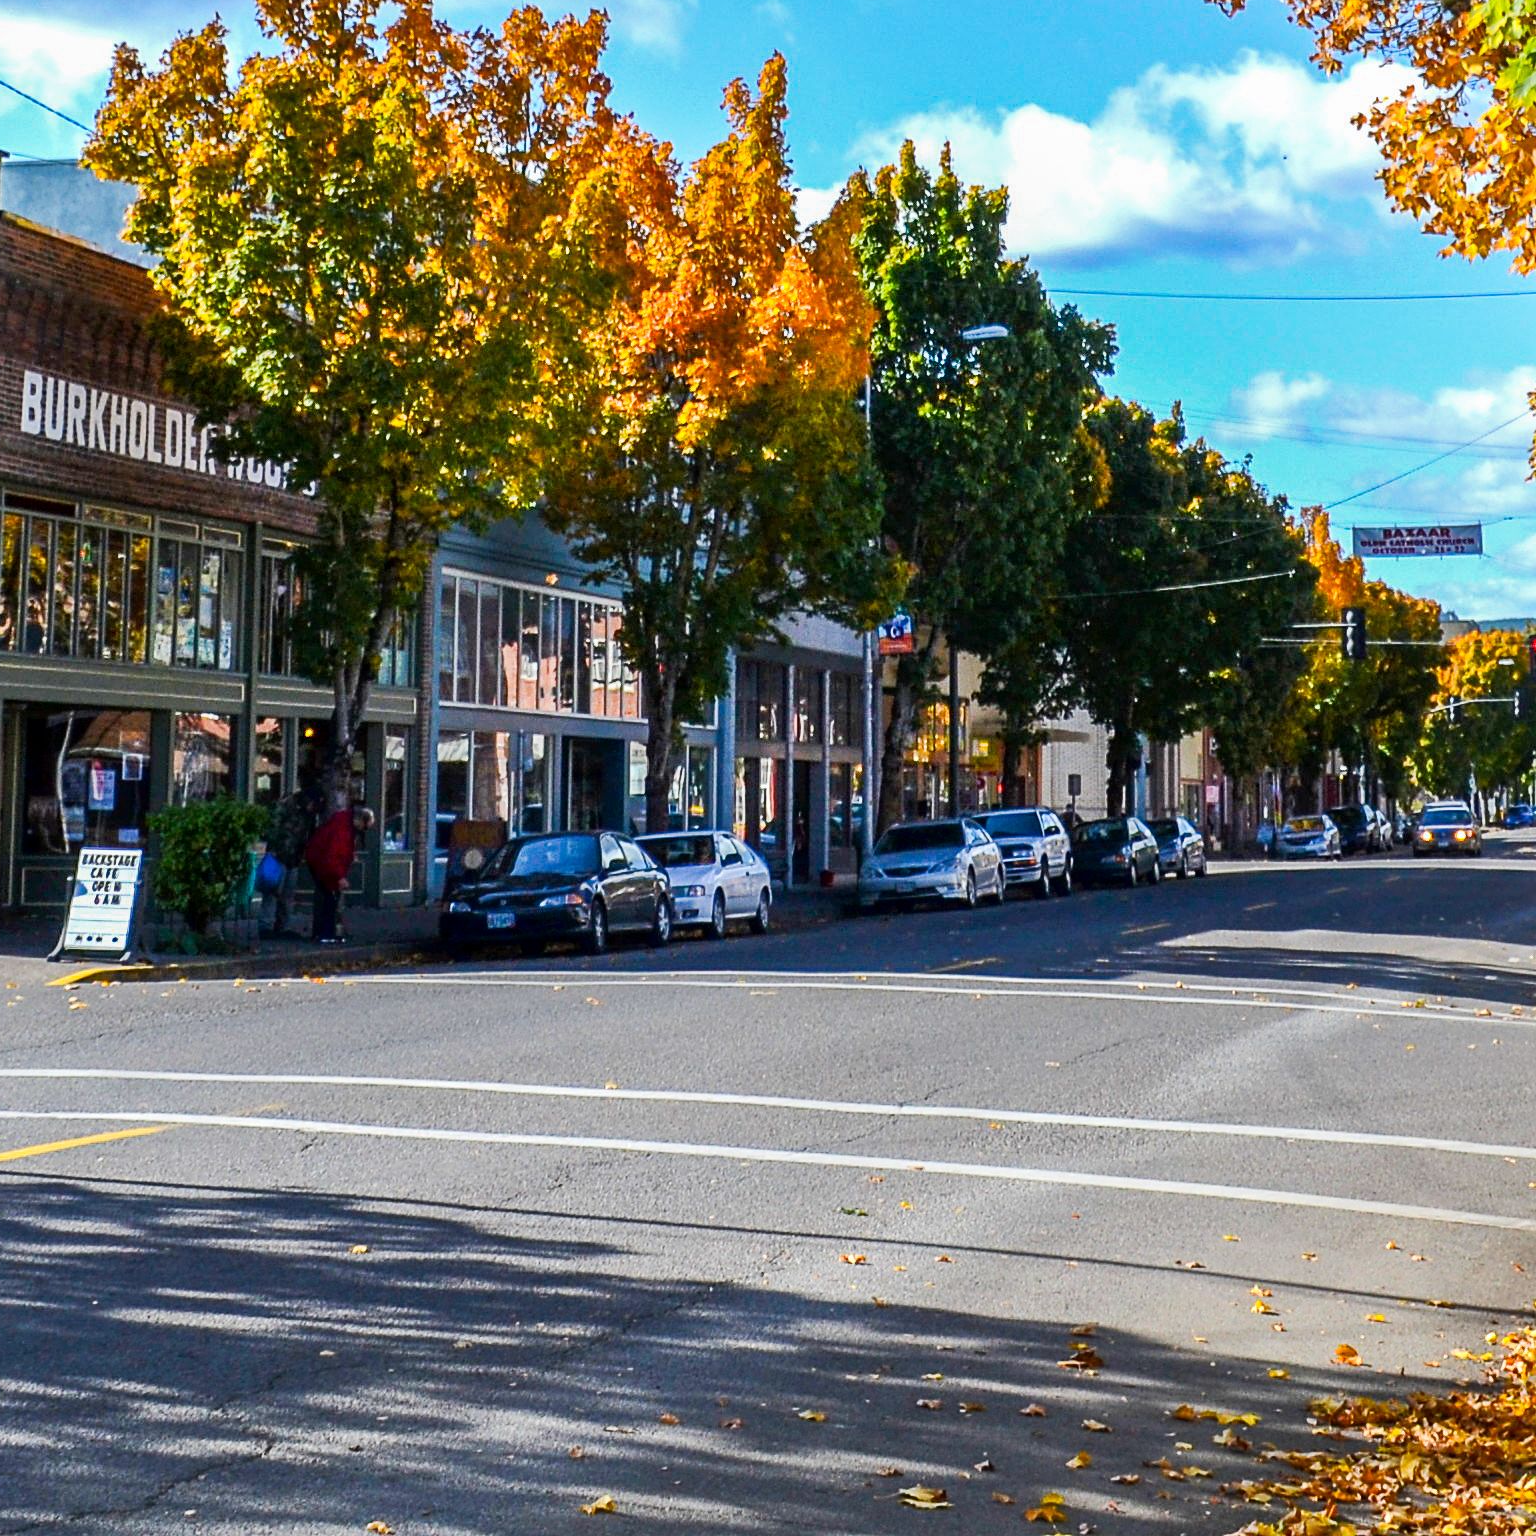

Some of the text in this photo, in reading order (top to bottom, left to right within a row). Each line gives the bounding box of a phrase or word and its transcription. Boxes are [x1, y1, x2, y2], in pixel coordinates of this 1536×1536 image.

[1383, 527, 1451, 539] BAZAAR
[1389, 538, 1434, 547] CATHOLIC
[1436, 537, 1475, 546] CHURCH
[82, 854, 138, 867] BACKSTAGE
[91, 868, 119, 880] CAFE
